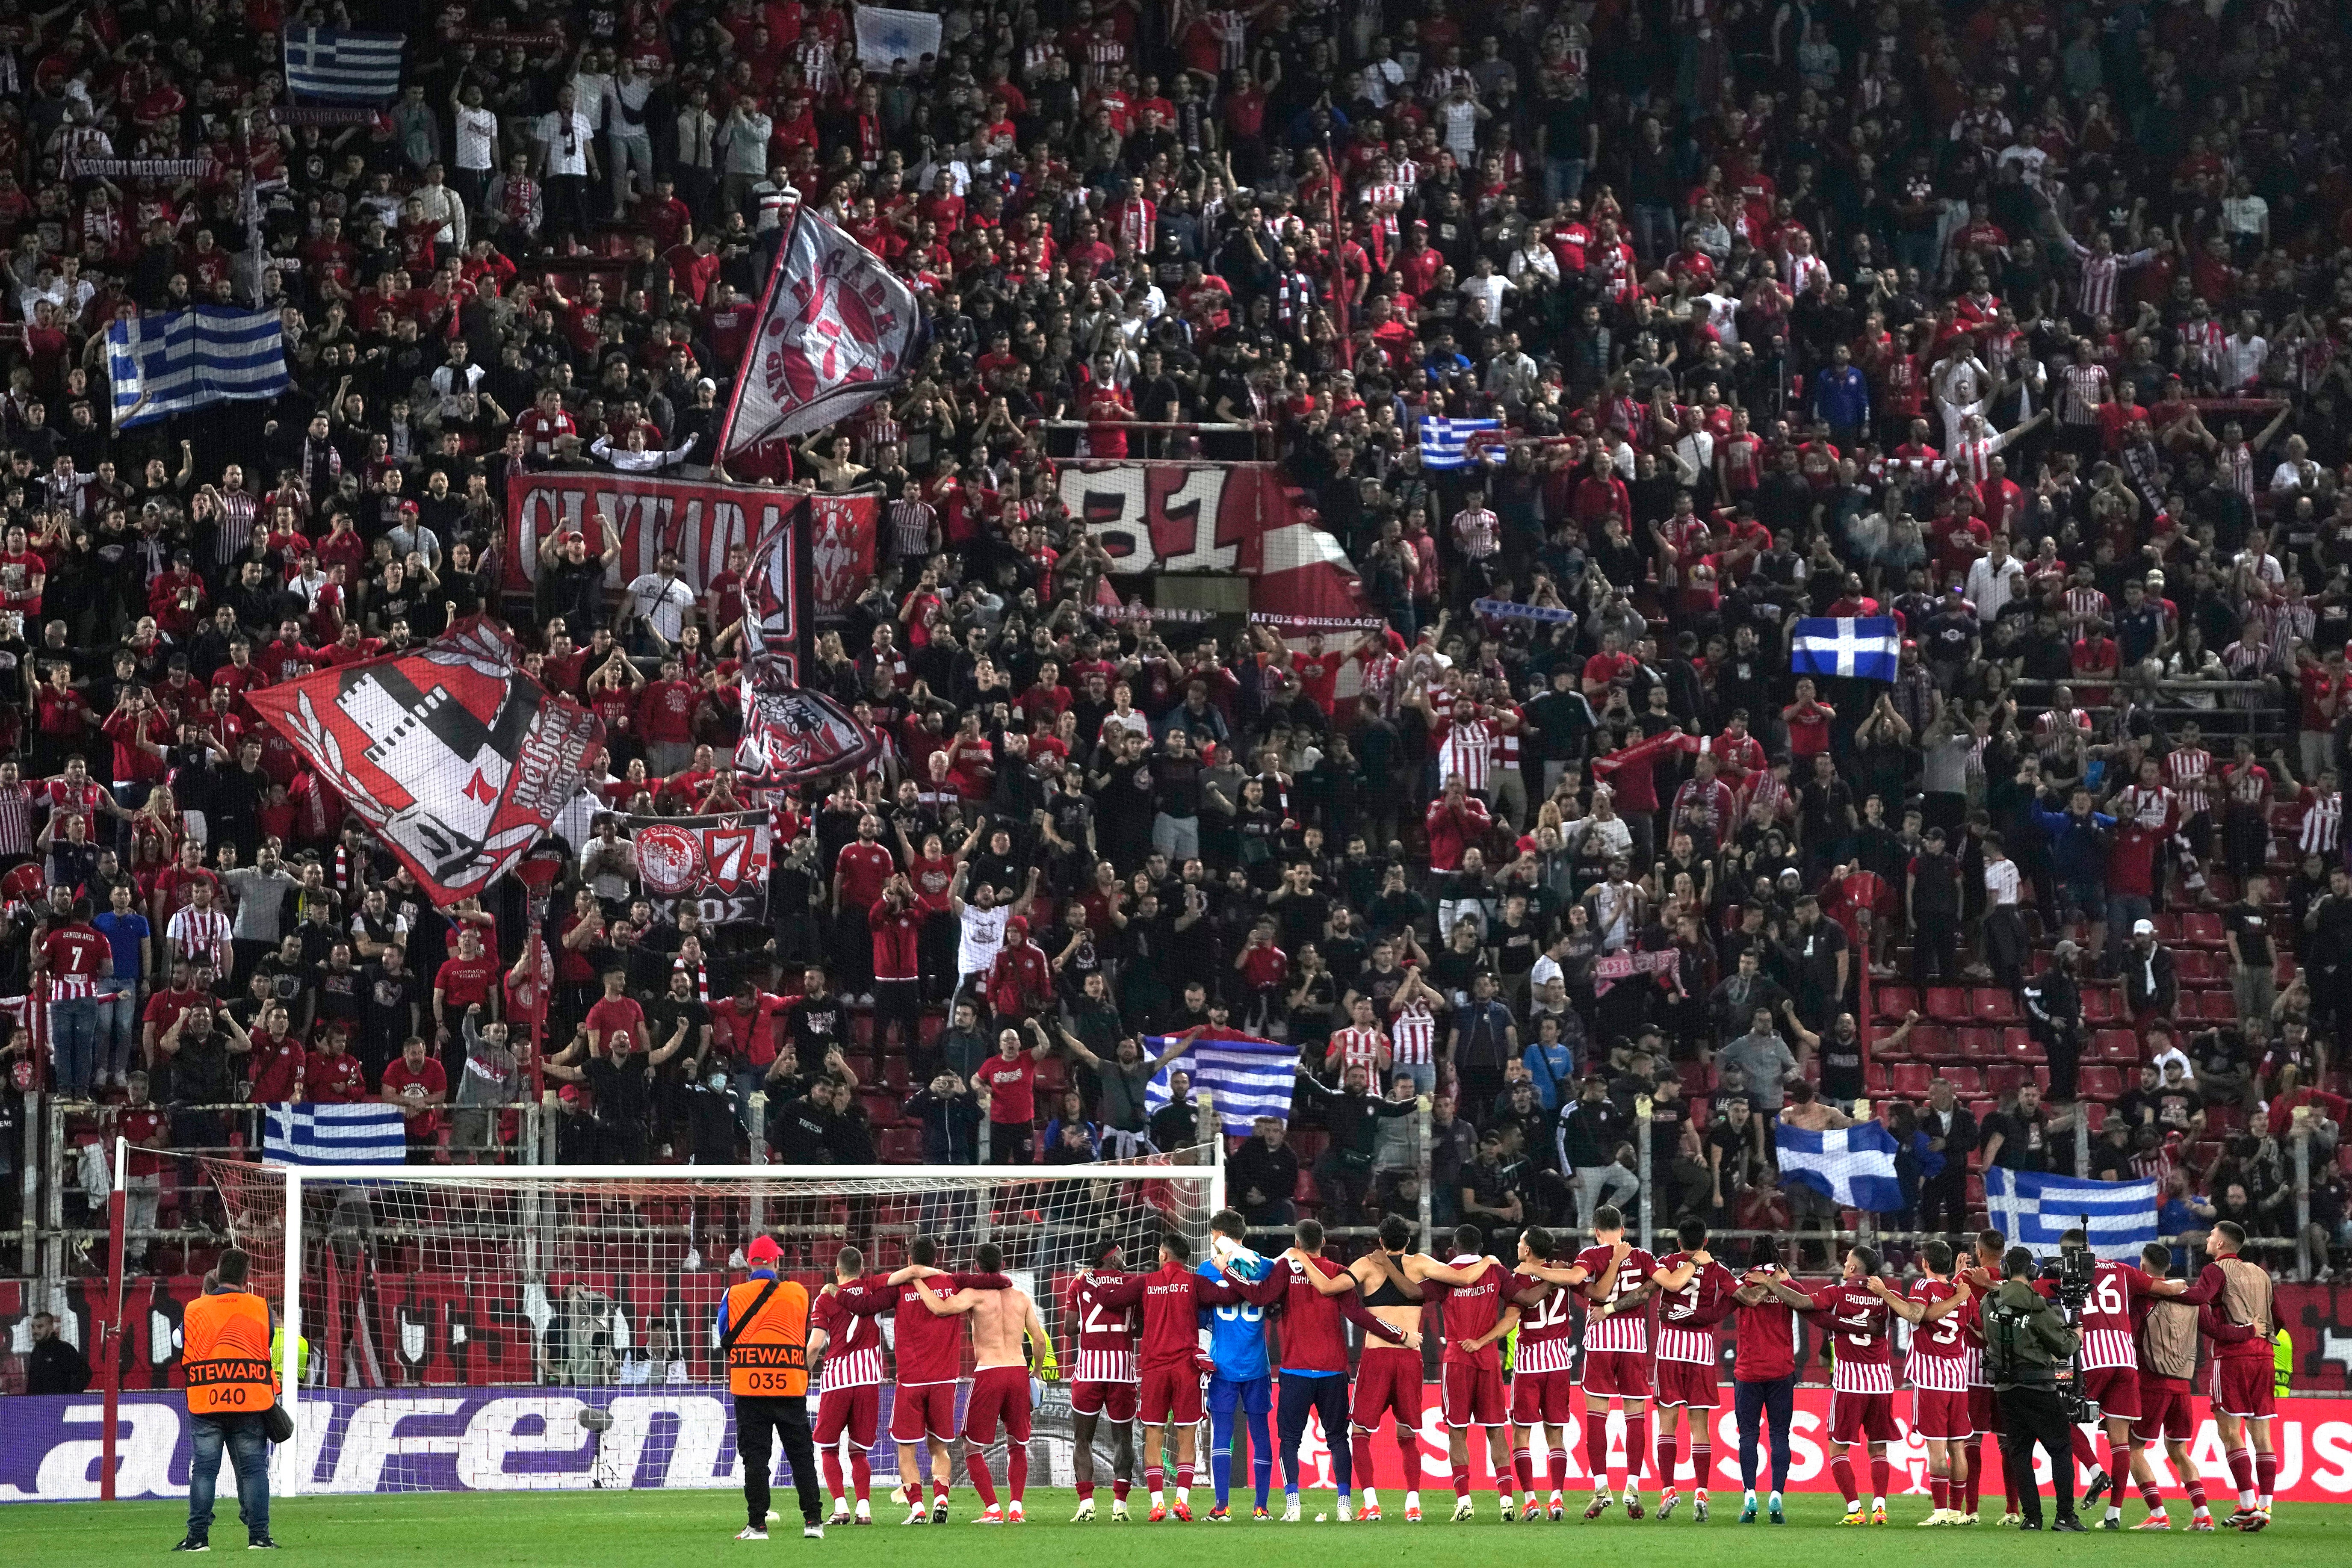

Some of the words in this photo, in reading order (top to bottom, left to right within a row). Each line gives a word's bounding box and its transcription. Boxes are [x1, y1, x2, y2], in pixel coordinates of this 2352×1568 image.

[72, 159, 128, 176] ΝΕΟΧΩΡΙ
[130, 159, 212, 177] ΜΕΣΟΛΟΓΓΙΟΥ
[1060, 467, 1238, 574] 81
[1251, 613, 1292, 625] ΑΓΙΟΣ
[1306, 617, 1381, 629] ΝΙΚΟΛΑΟΣ
[649, 827, 702, 866] ΟΛΥΜΠΙΑΚΟΣ
[713, 835, 747, 882] 7
[650, 897, 755, 924] ΧΟΣ
[62, 932, 83, 940] SENIOR
[71, 946, 83, 971] 7
[1093, 1275, 1124, 1285] ODINEI
[1179, 1282, 1189, 1293] FC
[1485, 1283, 1495, 1293] FC
[944, 1286, 954, 1297] FC
[1932, 1310, 1959, 1344] 5
[729, 1347, 806, 1367] STEWARD
[189, 1358, 267, 1383] STEWARD
[748, 1372, 787, 1390] 035
[209, 1388, 245, 1406] 040
